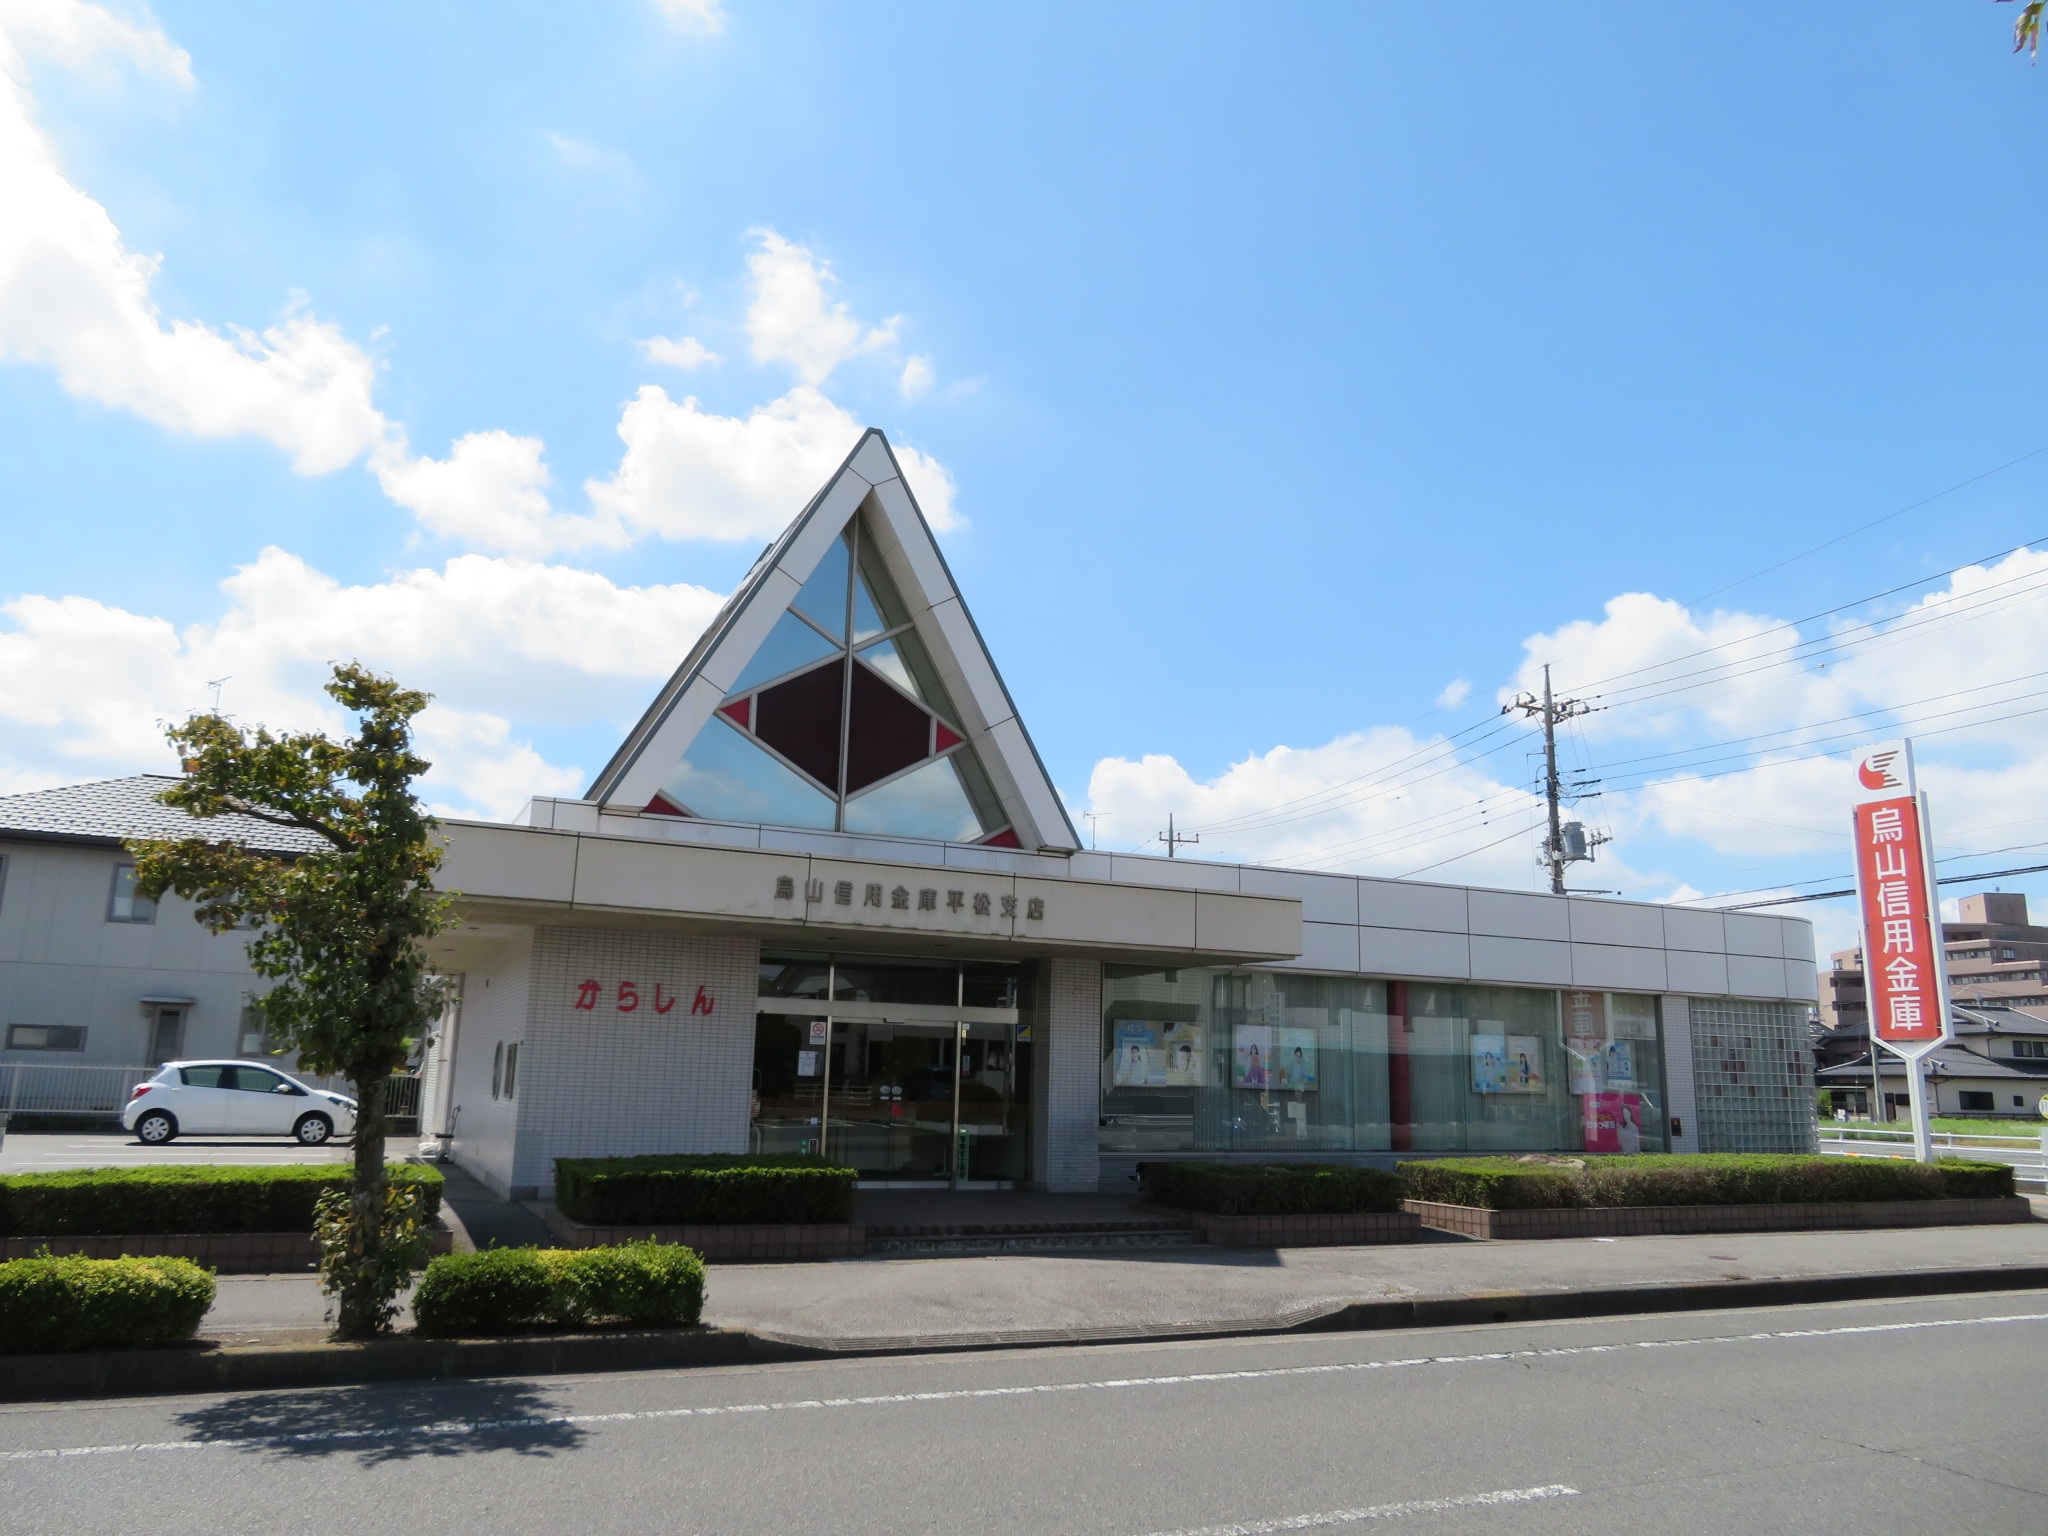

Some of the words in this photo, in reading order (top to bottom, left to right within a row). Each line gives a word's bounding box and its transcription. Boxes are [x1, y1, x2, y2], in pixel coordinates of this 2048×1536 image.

[774, 875, 1045, 920] 烏山信用金庫平松支店
[1871, 808, 1923, 1031] 烏山信用金庫
[575, 979, 714, 1016] からしん
